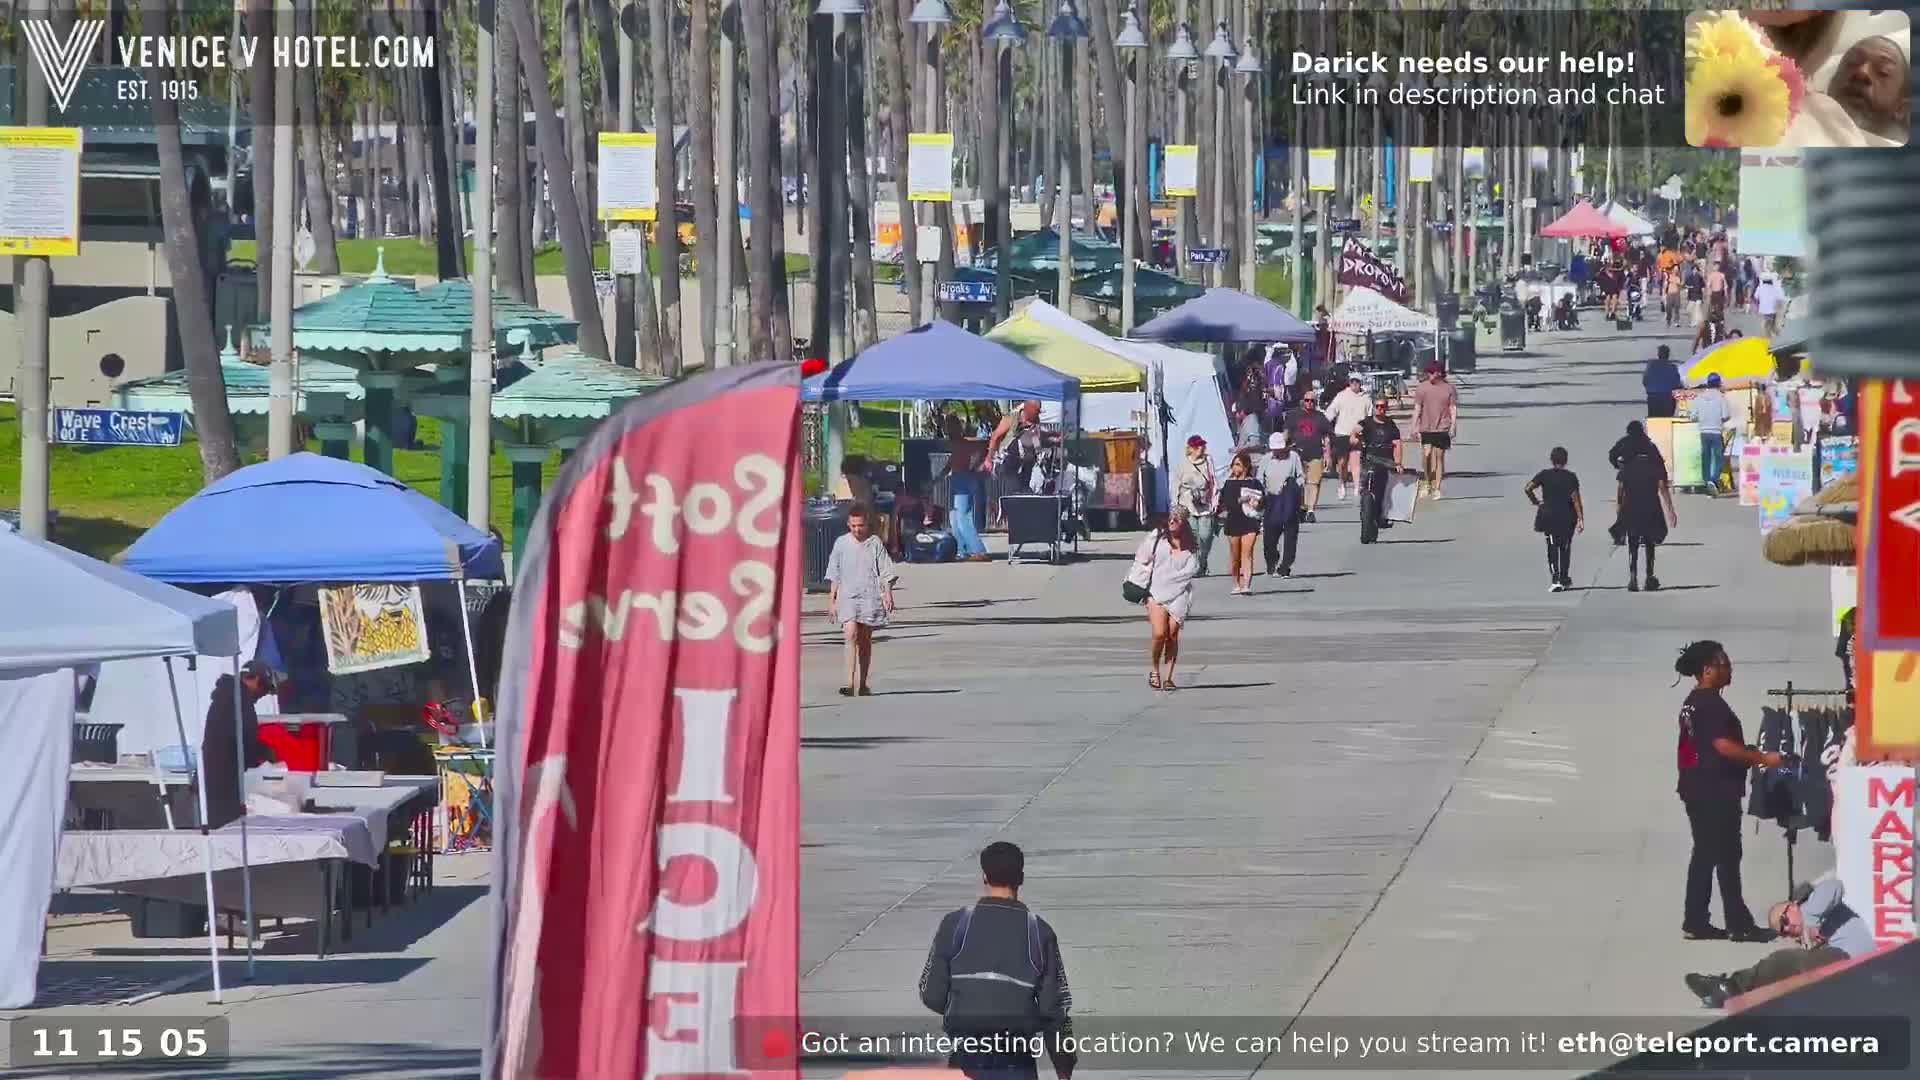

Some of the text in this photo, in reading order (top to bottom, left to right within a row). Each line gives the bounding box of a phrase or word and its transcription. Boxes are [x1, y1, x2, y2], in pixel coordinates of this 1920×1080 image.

[940, 282, 991, 295] Brooks Av
[60, 410, 152, 432] Wave Crest
[81, 428, 89, 441] E
[1867, 775, 1916, 947] MARKE
